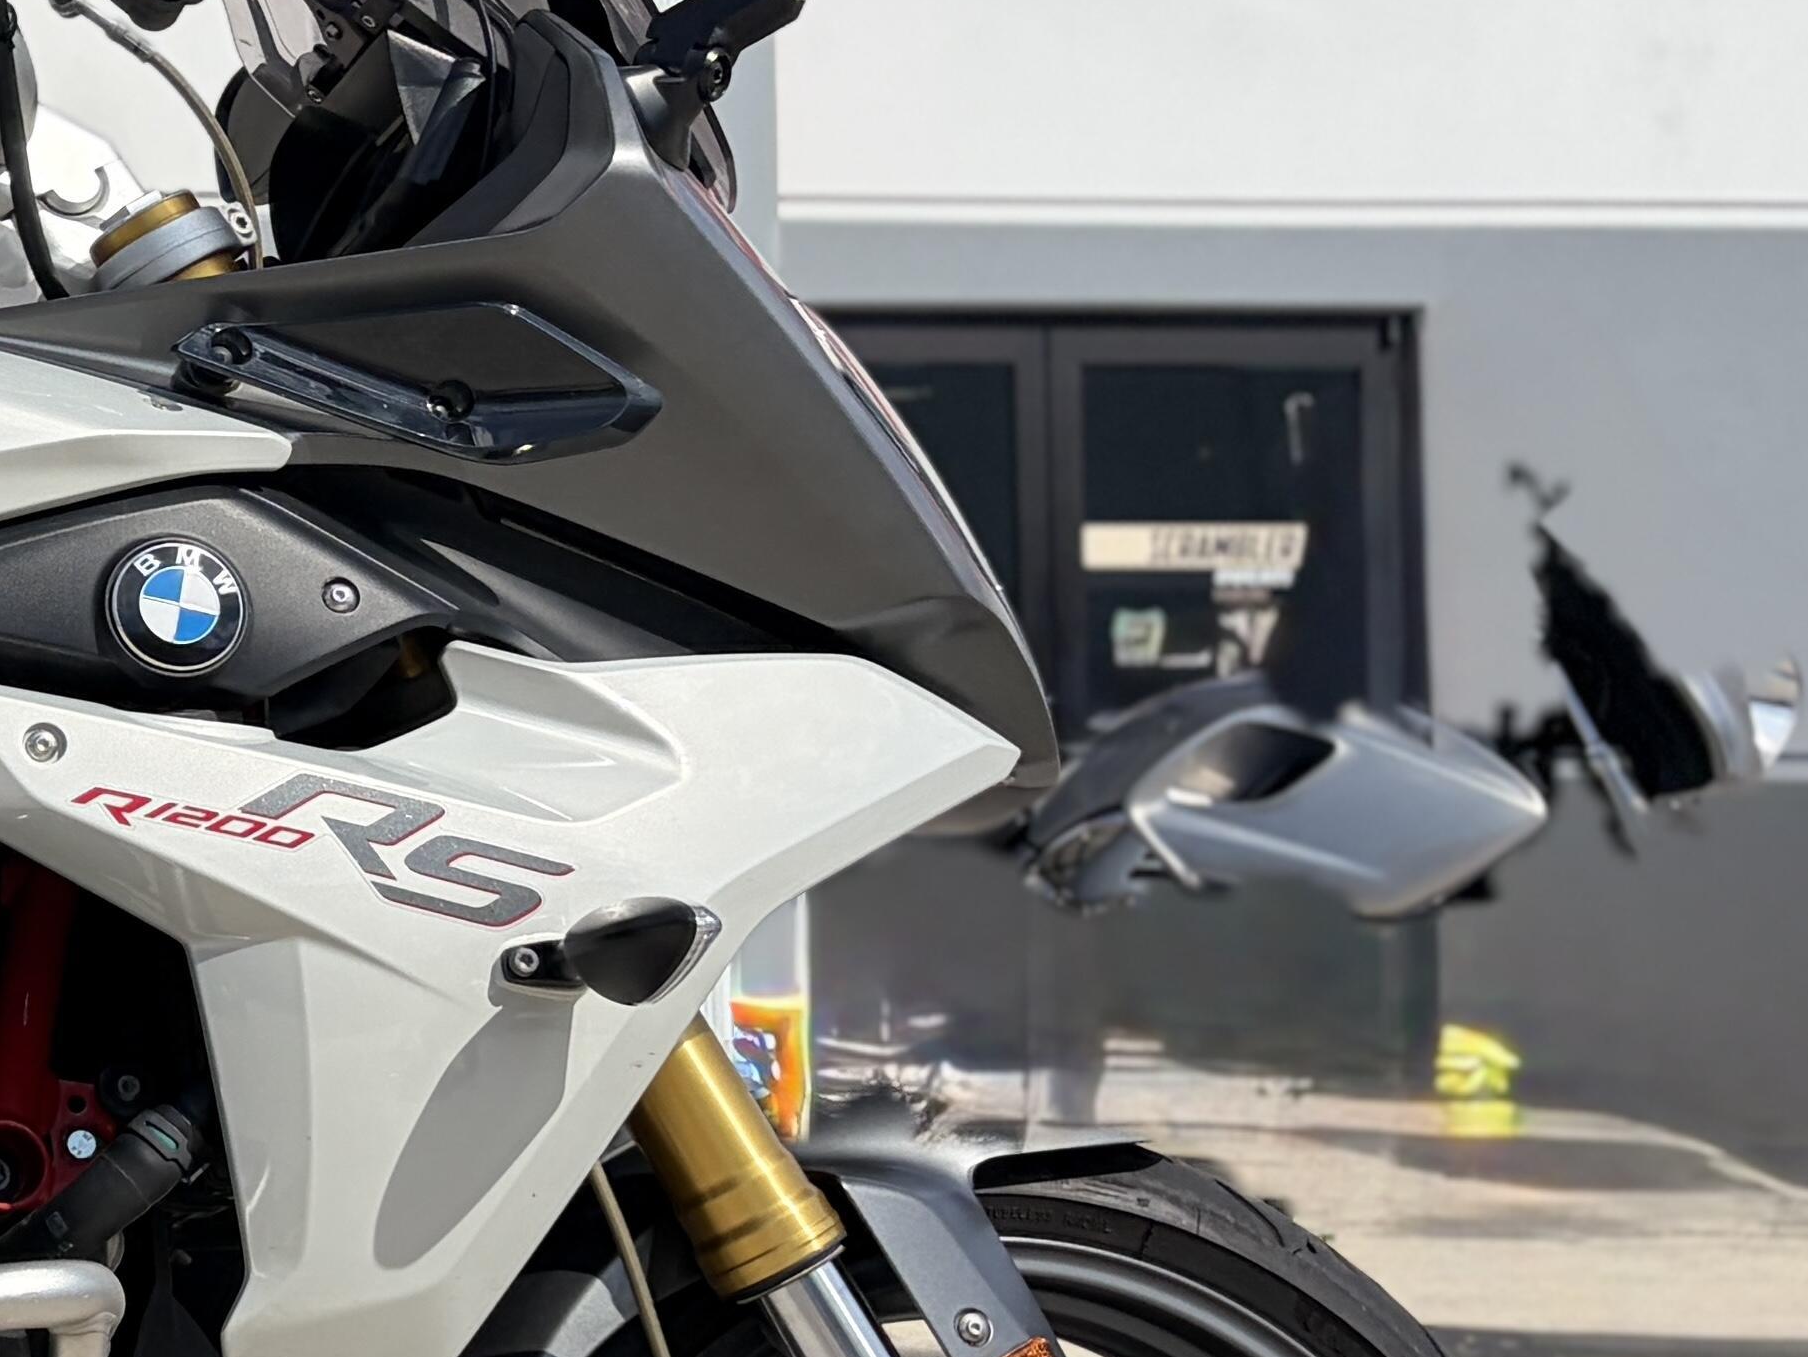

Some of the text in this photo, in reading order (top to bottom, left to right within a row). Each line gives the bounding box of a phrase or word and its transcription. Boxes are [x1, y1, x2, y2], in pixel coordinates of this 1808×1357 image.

[135, 546, 240, 597] BMW
[71, 772, 576, 928] R1200 RS
